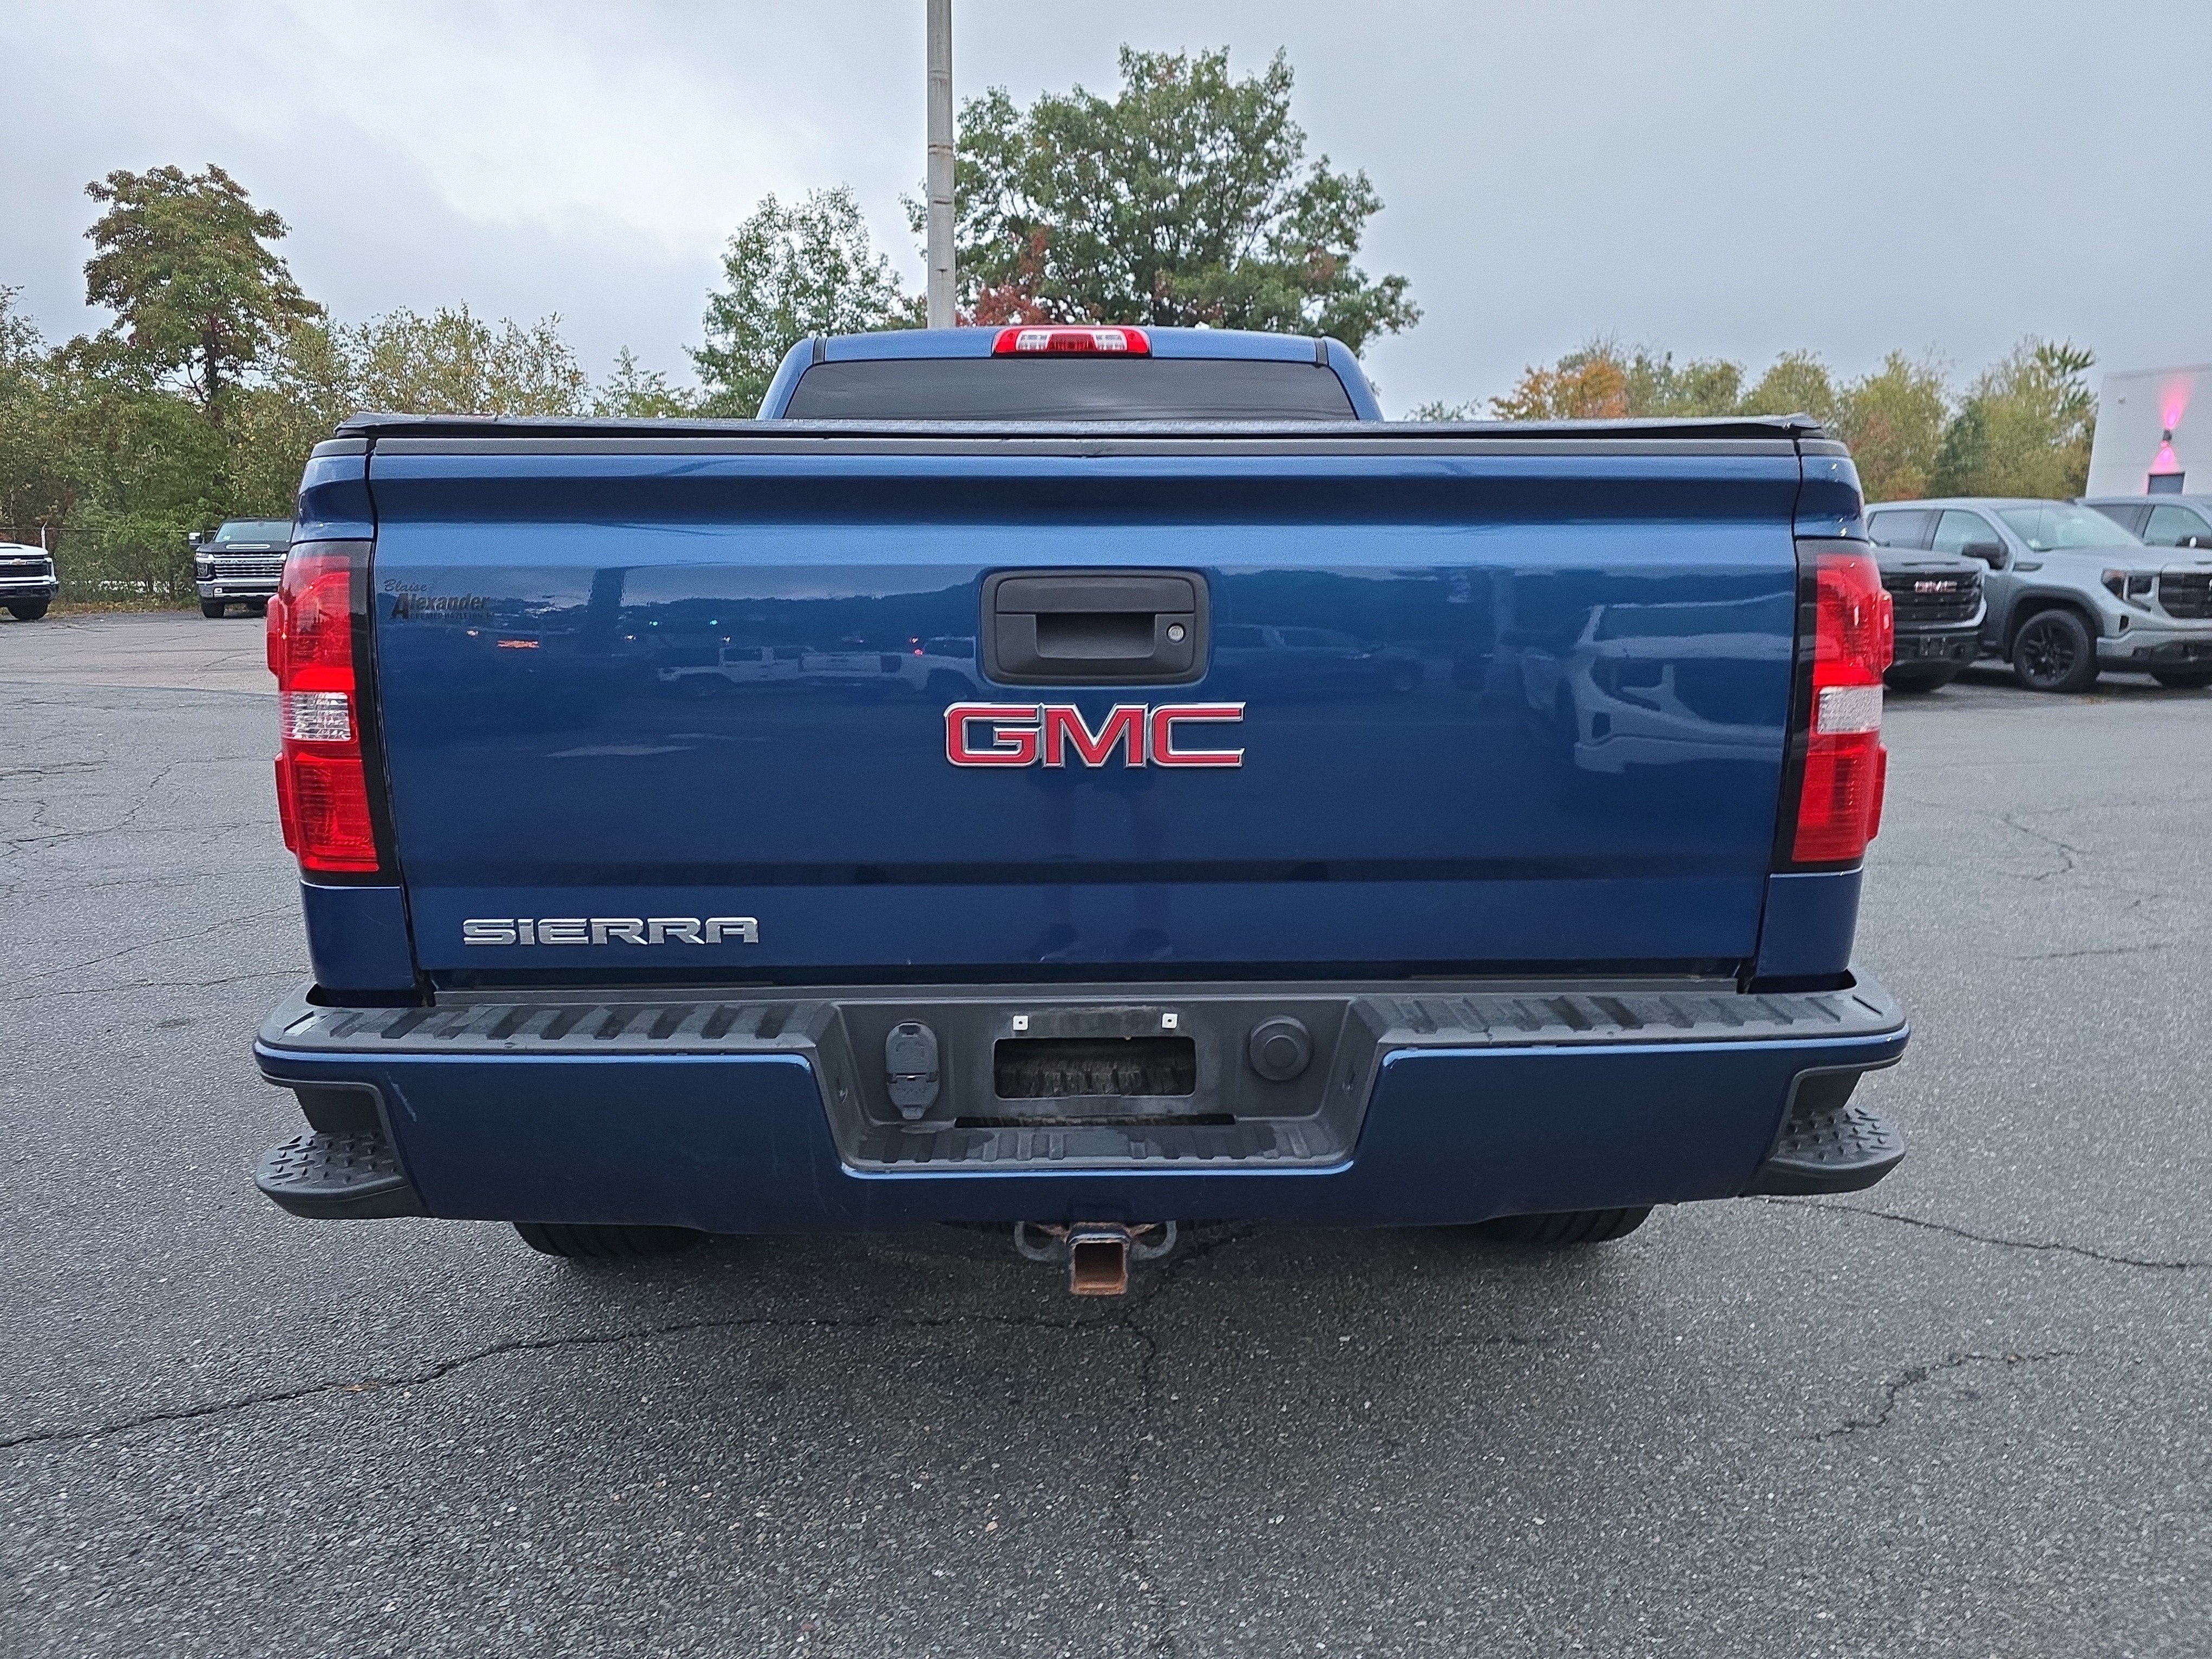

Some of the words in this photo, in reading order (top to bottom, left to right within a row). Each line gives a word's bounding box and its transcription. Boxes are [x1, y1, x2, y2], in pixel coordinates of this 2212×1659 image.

[384, 578, 428, 592] Blaise
[1914, 581, 1957, 593] GMC
[391, 592, 490, 619] Alexander
[943, 702, 1246, 768] GMC
[463, 917, 759, 944] SIERRA
